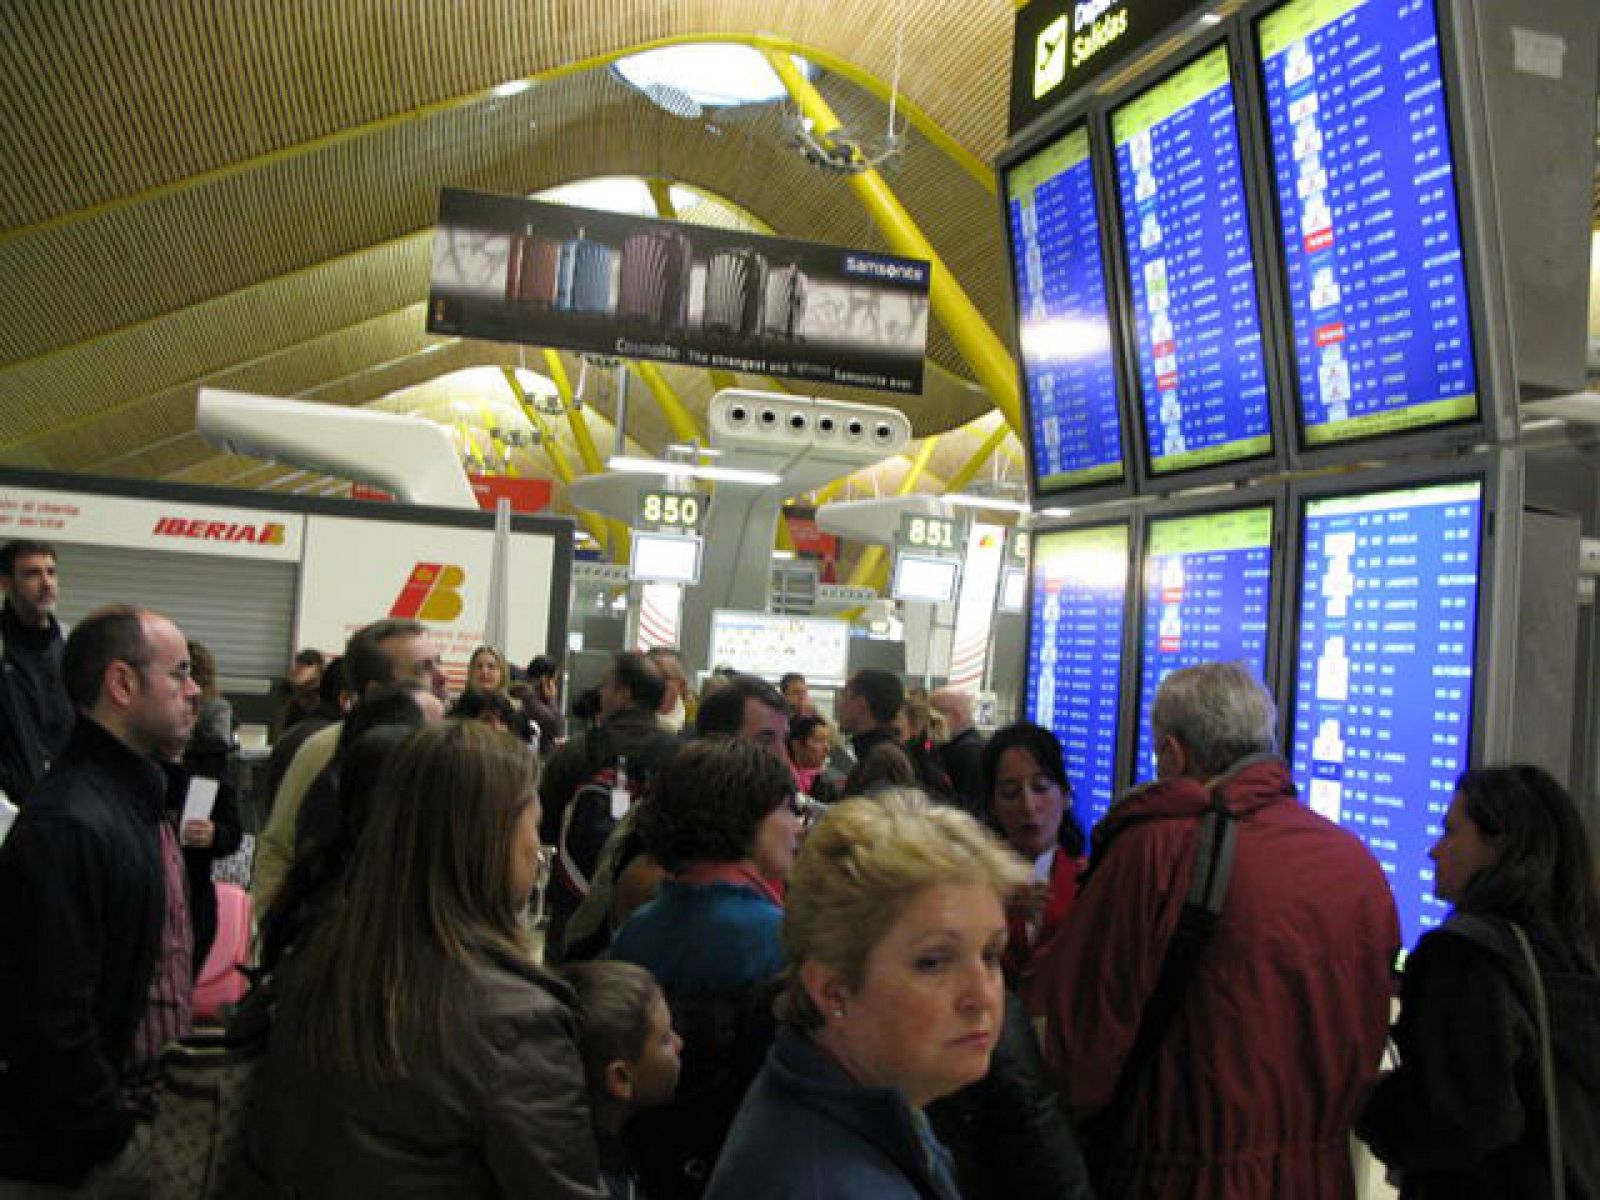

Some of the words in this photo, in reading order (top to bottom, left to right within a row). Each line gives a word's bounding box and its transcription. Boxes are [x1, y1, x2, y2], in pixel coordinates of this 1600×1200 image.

[1072, 7, 1128, 67] Salidas
[644, 494, 699, 526] 850
[152, 517, 256, 543] IBERIA
[909, 518, 952, 549] 851
